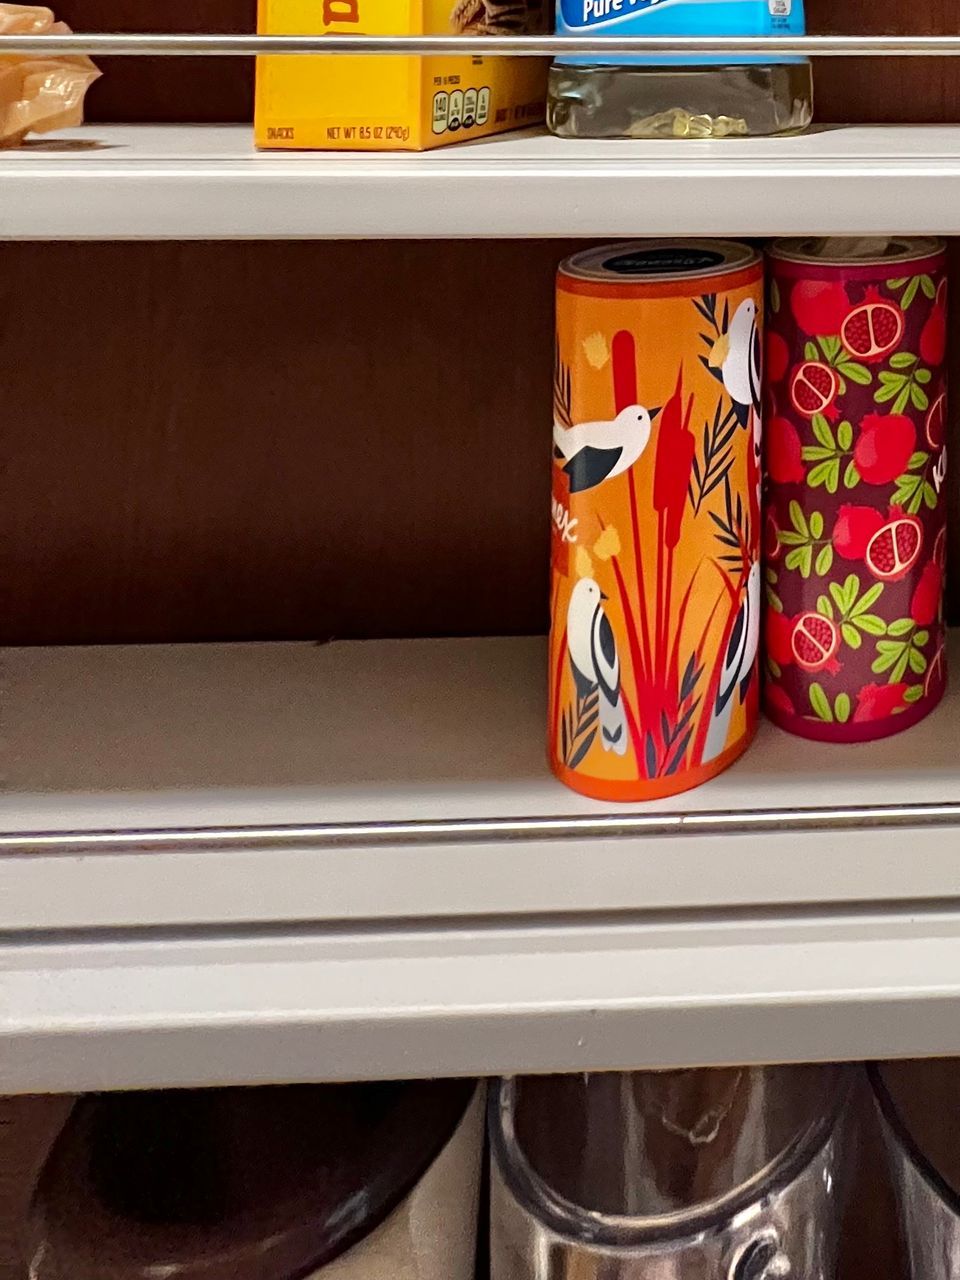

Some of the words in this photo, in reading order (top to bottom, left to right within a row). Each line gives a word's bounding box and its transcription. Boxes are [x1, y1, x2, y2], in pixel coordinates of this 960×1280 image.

[266, 127, 295, 140] SNACKS
[327, 127, 340, 140] NET
[343, 127, 356, 139] WT
[359, 127, 371, 139] 8.5
[374, 127, 383, 139] OZ
